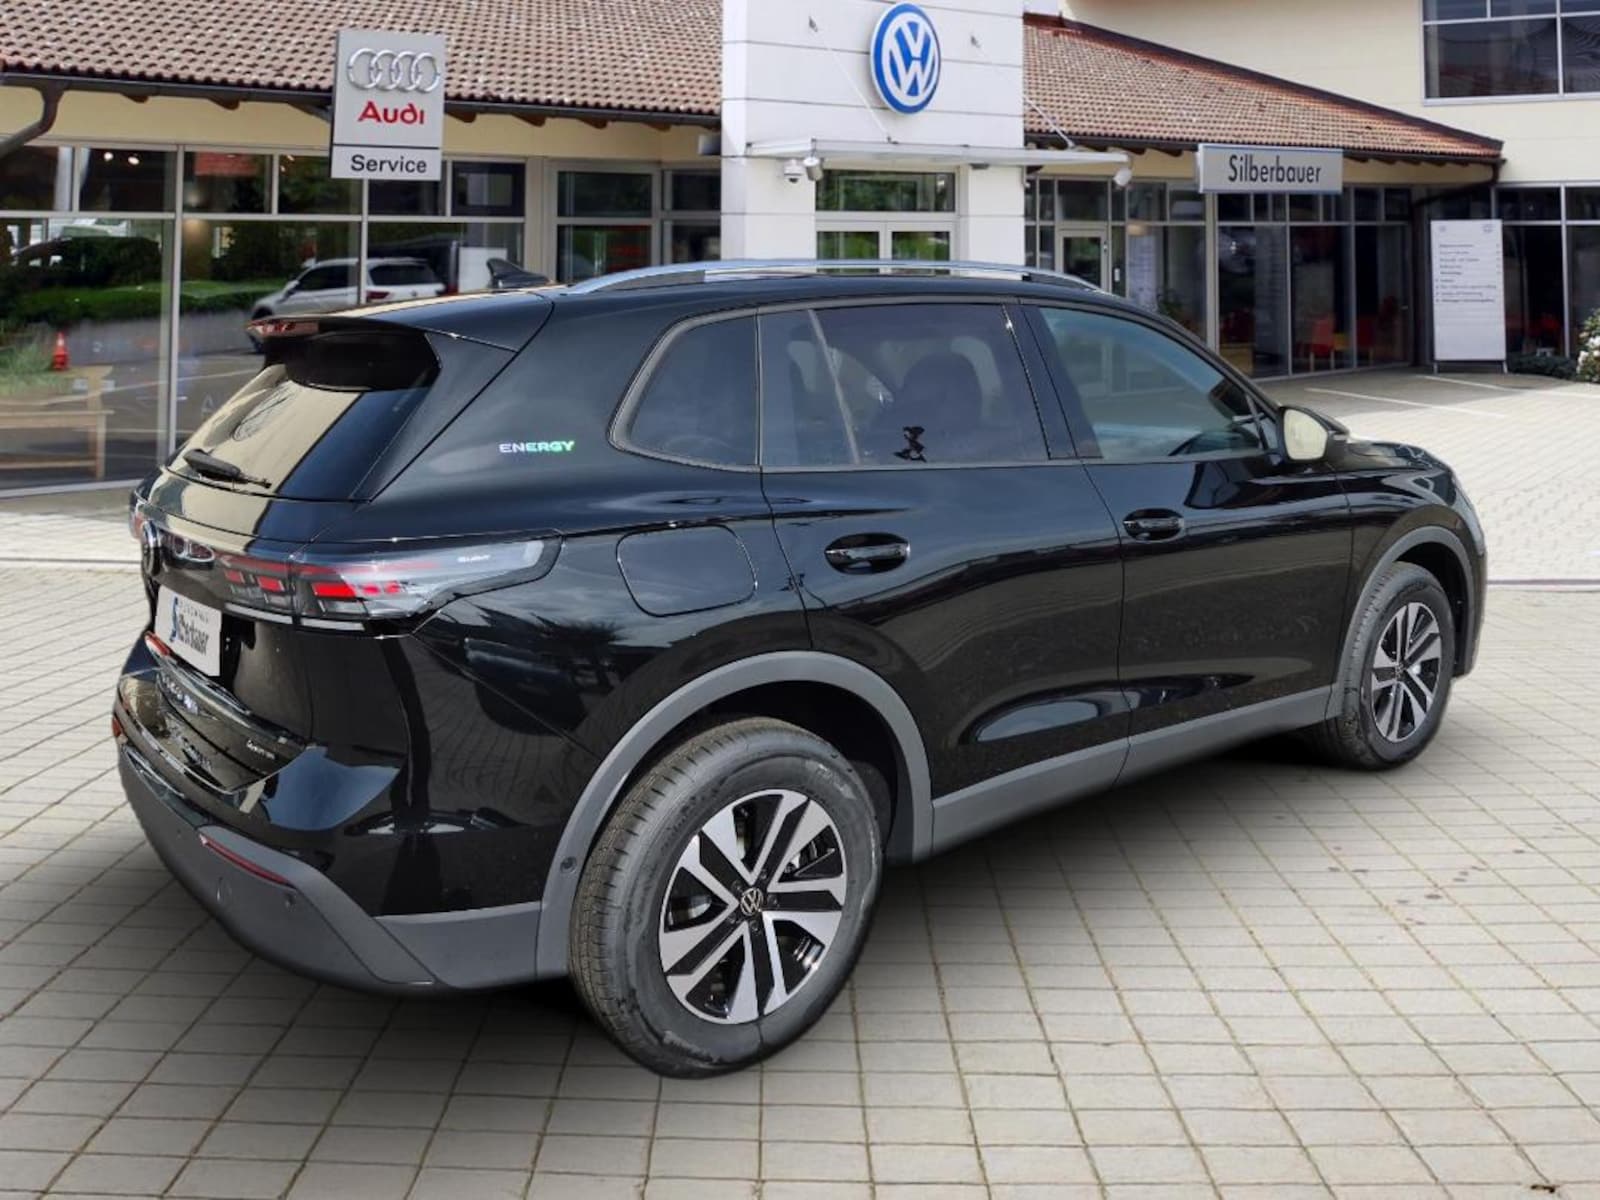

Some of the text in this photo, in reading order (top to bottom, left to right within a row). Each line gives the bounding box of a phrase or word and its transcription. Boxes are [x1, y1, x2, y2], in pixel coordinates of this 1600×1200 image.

[878, 9, 938, 108] VW
[357, 101, 424, 125] Audi
[351, 154, 427, 173] Service
[1228, 154, 1321, 183] Silberbauer
[499, 441, 575, 453] ENERGY
